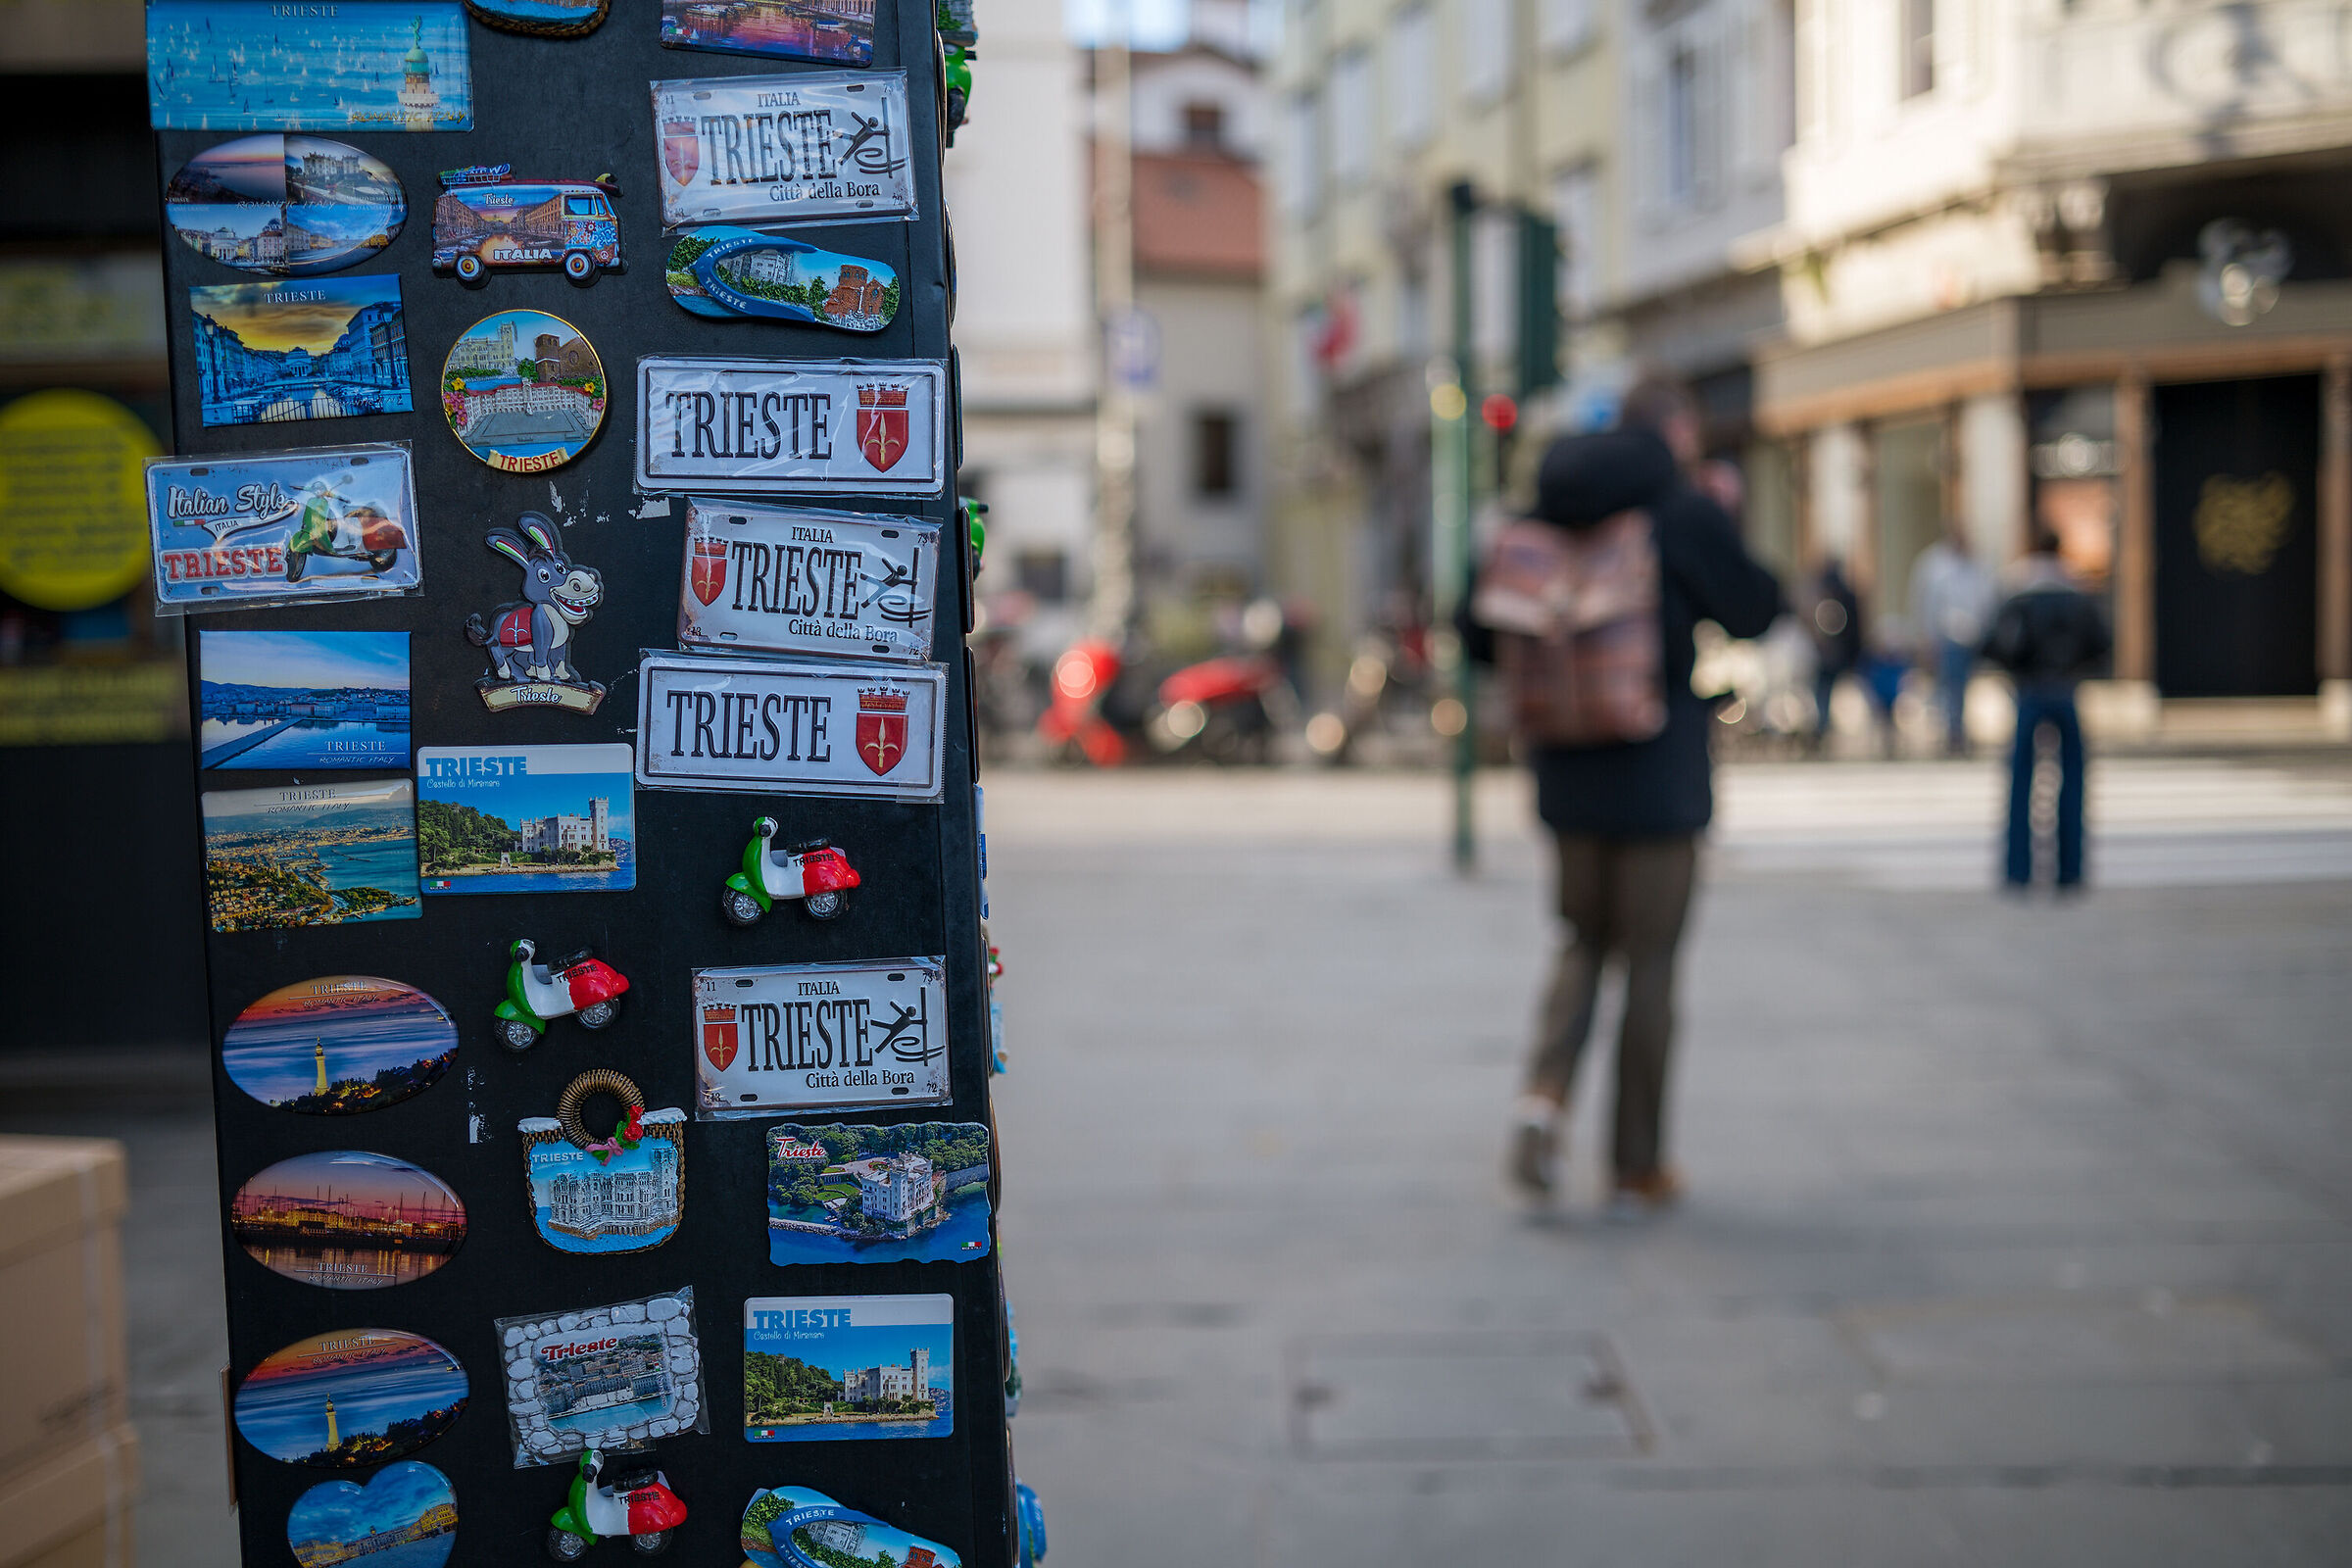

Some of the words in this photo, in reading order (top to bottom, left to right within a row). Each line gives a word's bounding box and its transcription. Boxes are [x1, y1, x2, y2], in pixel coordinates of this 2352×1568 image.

[269, 5, 338, 17] TRIESTE
[757, 92, 801, 108] ITALIA
[701, 110, 837, 185] TRIESTE
[769, 184, 804, 202] Città
[808, 181, 842, 200] della
[846, 181, 880, 197] Bora
[237, 199, 297, 210] ROMANTIC
[483, 193, 514, 207] Trieste
[494, 248, 552, 261] ITALIA
[707, 238, 755, 259] TRIESTE
[264, 290, 326, 304] TRIESTE
[705, 276, 747, 310] TRIESTE
[665, 391, 832, 460] TRIESTE
[500, 452, 561, 471] TRIESTE
[168, 485, 228, 518] Italian
[235, 482, 287, 519] Style
[214, 520, 239, 533] ITALIA
[791, 526, 834, 544] ITALIA
[163, 547, 284, 580] TRIESTE
[732, 540, 862, 620] TRIESTE
[788, 618, 821, 637] Città
[826, 621, 860, 640] della
[865, 625, 898, 643] Bora
[511, 686, 563, 705] Trieste
[666, 689, 831, 762] TRIESTE
[324, 741, 386, 752] TRIESTE
[368, 756, 395, 764] ITALY
[425, 757, 526, 776] TRIESTE
[426, 778, 457, 788] Castello
[458, 778, 466, 788] di
[279, 789, 336, 801] TRIESTE
[267, 804, 316, 814] ROMANTIC
[321, 802, 351, 811] ITALY
[793, 854, 834, 867] TRIESTE
[557, 964, 598, 983] TRIESTE
[311, 981, 368, 995] TRIESTE
[797, 981, 840, 996] ITALIA
[741, 999, 873, 1071] TRIESTE
[806, 1070, 840, 1089] Città
[844, 1070, 878, 1087] della
[882, 1069, 915, 1085] Bora
[775, 1137, 826, 1158] Trieste
[532, 1152, 584, 1163] TRIESTE
[318, 1262, 368, 1273] TRIESTE
[307, 1274, 352, 1283] ROMANTIC
[357, 1276, 383, 1286] ITALY
[753, 1308, 851, 1328] TRIESTE
[318, 1336, 376, 1351] TRIESTE
[754, 1331, 782, 1341] Castello
[784, 1331, 791, 1340] di
[541, 1337, 617, 1361] Trieste
[618, 1491, 660, 1504] TRIESTE
[786, 1509, 834, 1525] TRIESTE
